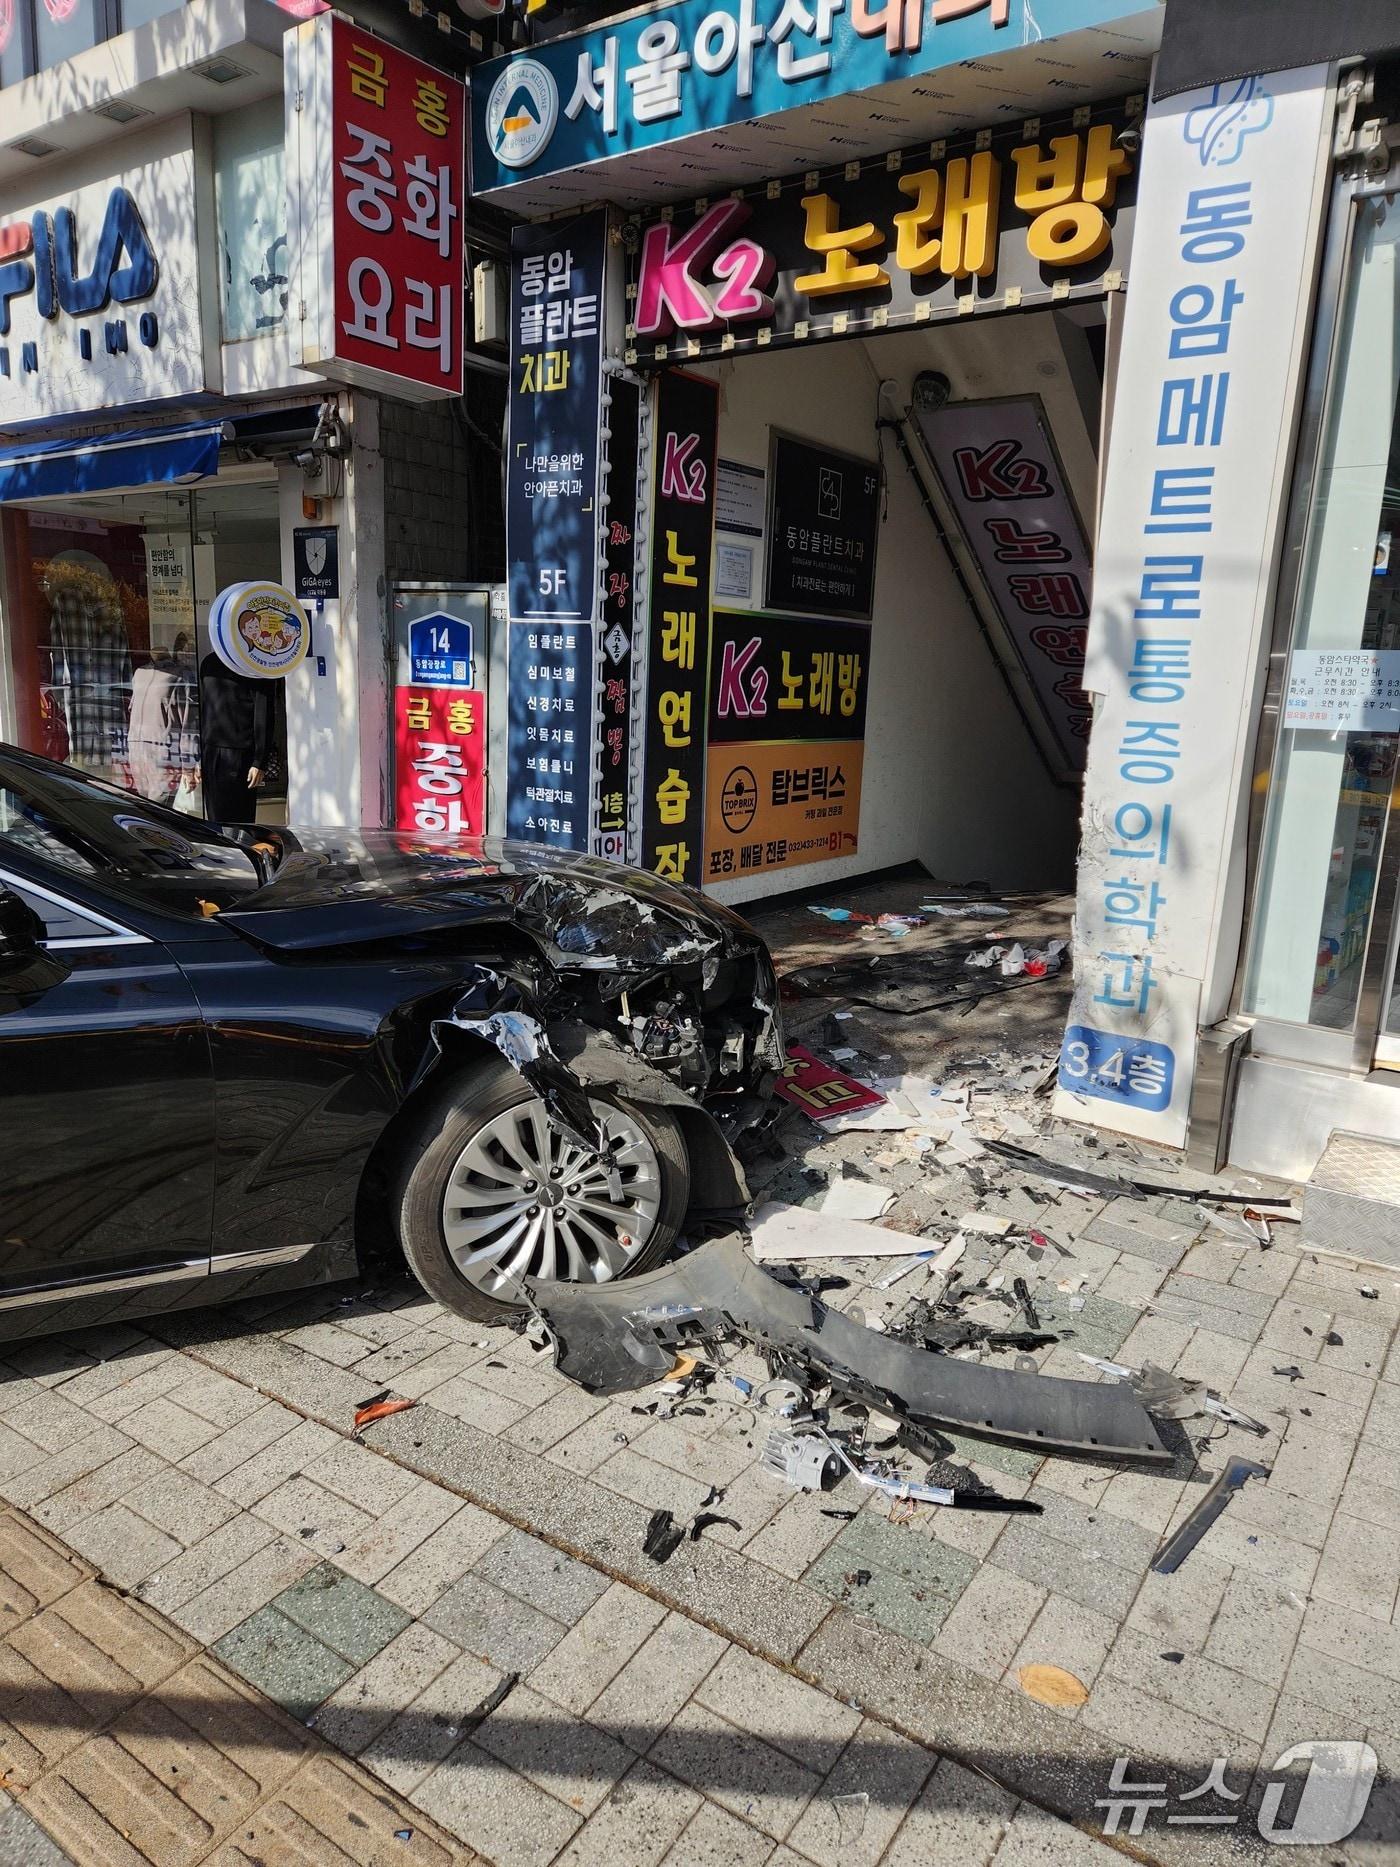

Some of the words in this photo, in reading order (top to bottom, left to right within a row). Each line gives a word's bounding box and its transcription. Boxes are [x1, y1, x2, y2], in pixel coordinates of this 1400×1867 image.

[346, 42, 450, 137] 금홍
[339, 120, 457, 257] 중화
[634, 198, 776, 338] K2
[794, 123, 1132, 298] 노래방
[0, 186, 159, 335] FILA
[520, 249, 575, 297] 동암
[341, 256, 453, 373] 요리
[519, 294, 598, 345] 플란트
[519, 349, 571, 394] 치과
[524, 453, 585, 473] 나만을위한
[661, 431, 706, 502] K2
[953, 438, 1054, 503] K2
[523, 479, 583, 499] 안아픈치과
[863, 476, 877, 495] 5F
[787, 526, 864, 561] 동암플란트치과
[539, 568, 567, 596] 5F
[430, 627, 451, 654] 14
[528, 633, 577, 650] 임플란트
[527, 665, 576, 683] 심미보철
[1314, 667, 1353, 677] 근무시간
[1361, 667, 1380, 677] 안내
[1319, 655, 1369, 665] 동암스타약국
[718, 637, 769, 718] K2
[778, 650, 861, 717] 노래방
[406, 697, 475, 736] 금홍
[526, 696, 575, 713] 신경치료
[525, 785, 574, 804] 턱관절치료
[771, 766, 846, 806] 탑브릭스
[603, 791, 624, 814] 1층
[725, 800, 738, 810] TOP
[738, 797, 754, 808] BRIX
[525, 815, 573, 835] 소아진료
[740, 843, 763, 869] 배달
[765, 839, 787, 865] 전문
[829, 831, 842, 852] B1
